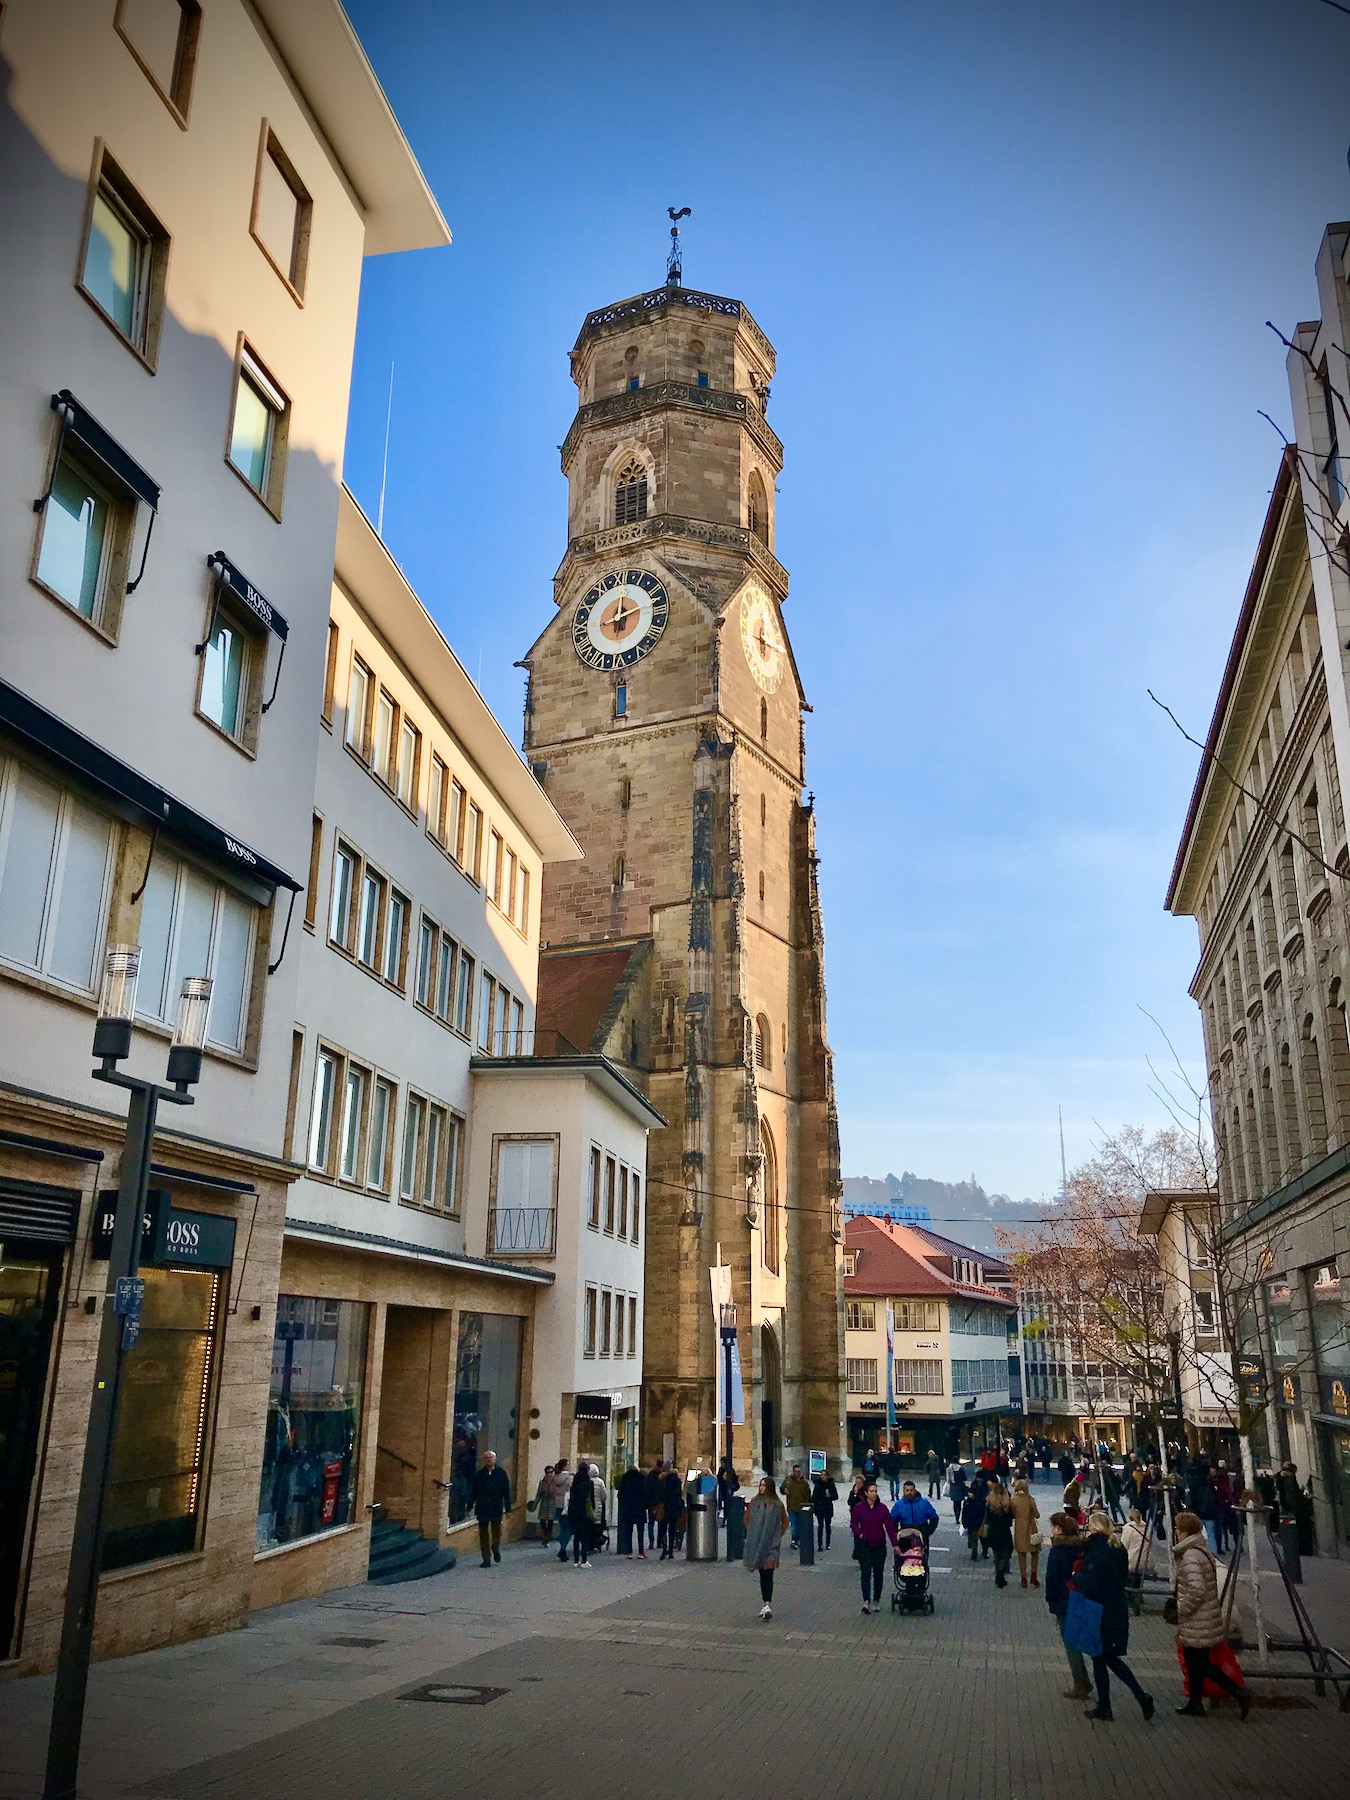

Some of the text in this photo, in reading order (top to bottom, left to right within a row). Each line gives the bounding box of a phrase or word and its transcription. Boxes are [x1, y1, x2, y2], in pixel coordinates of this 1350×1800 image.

[613, 571, 628, 587] XII
[593, 580, 608, 597] XI
[648, 584, 661, 597] II
[246, 583, 273, 621] BOSS
[580, 602, 593, 612] X
[654, 604, 666, 616] III
[635, 645, 648, 658] V
[612, 654, 627, 669] VI
[224, 836, 257, 865] BOSS
[859, 1401, 910, 1411] MONTANC
